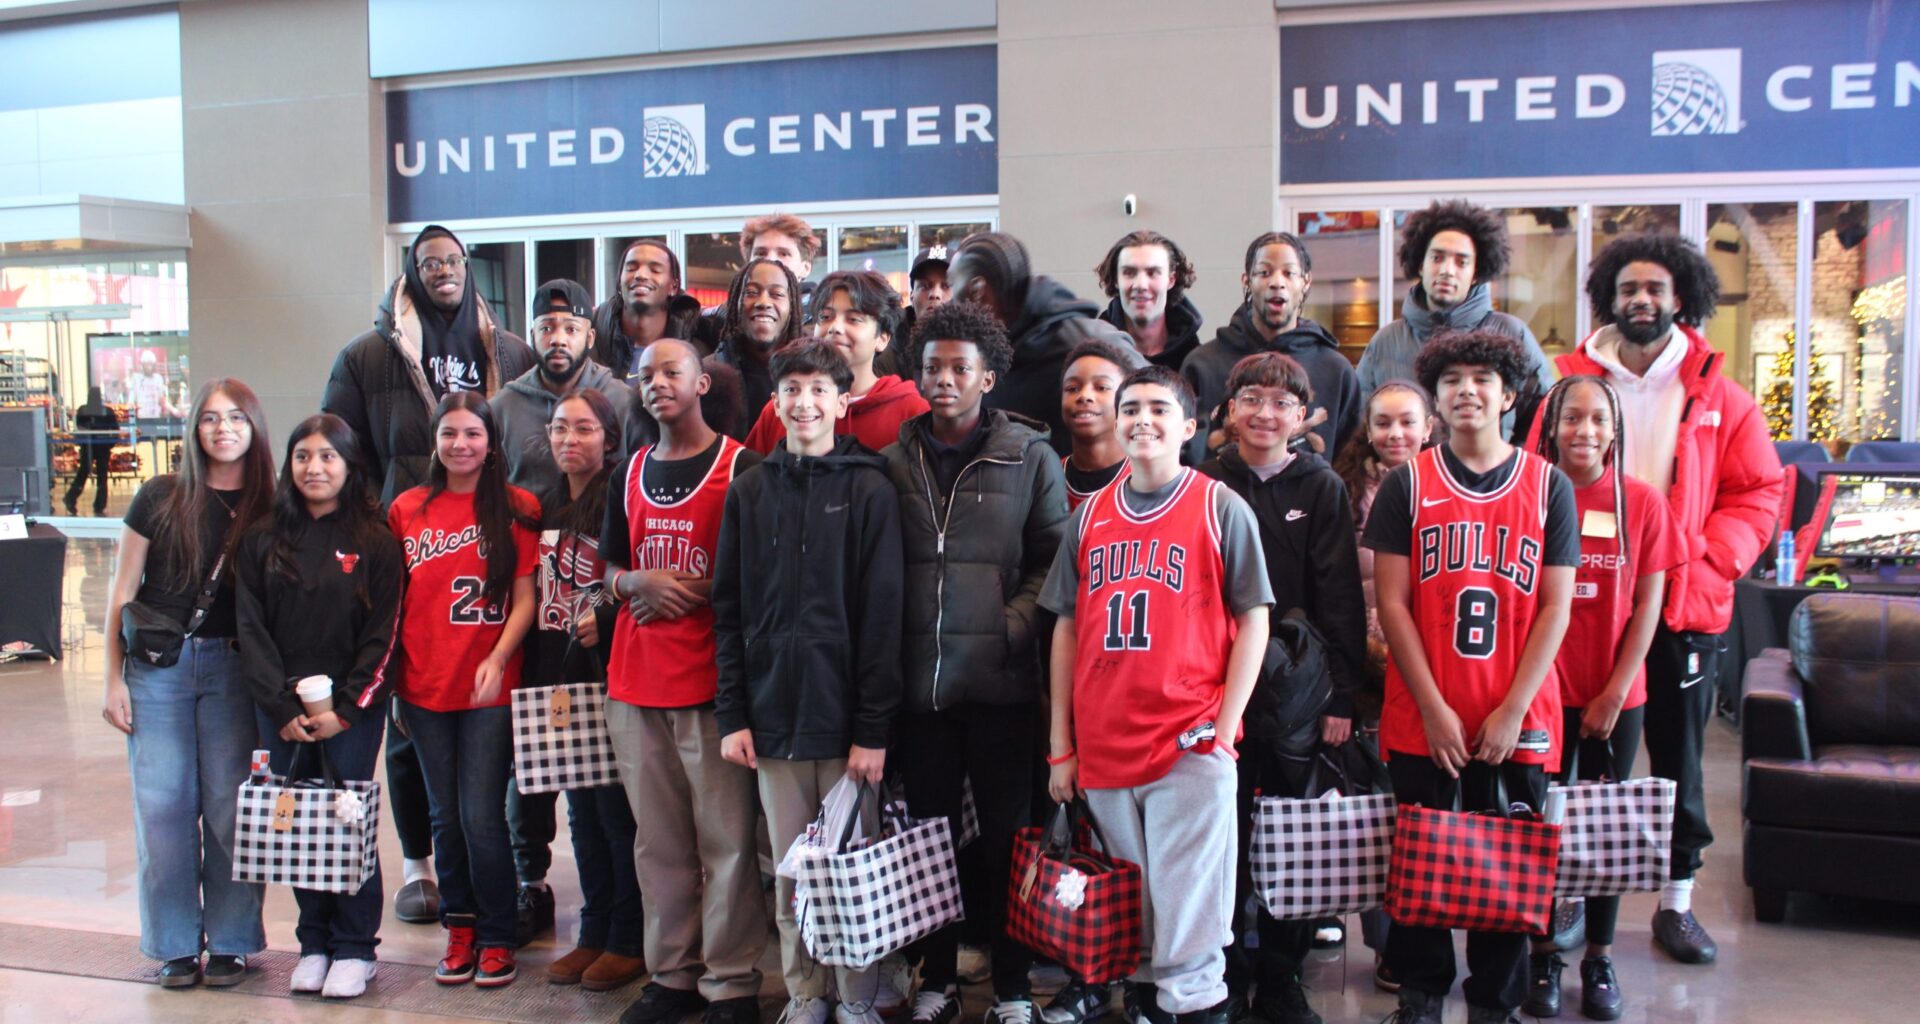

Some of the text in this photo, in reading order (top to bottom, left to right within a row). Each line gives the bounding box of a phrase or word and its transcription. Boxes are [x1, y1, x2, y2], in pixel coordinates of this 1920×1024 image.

[1293, 74, 1626, 129] UNITED
[394, 103, 994, 177] UNITED CENTER
[403, 524, 491, 573] Chica
[646, 518, 694, 532] HICAGO
[1088, 539, 1186, 597] BULLS
[1419, 521, 1540, 596] BULLS
[1104, 589, 1151, 651] 11
[1453, 586, 1499, 659] 8
